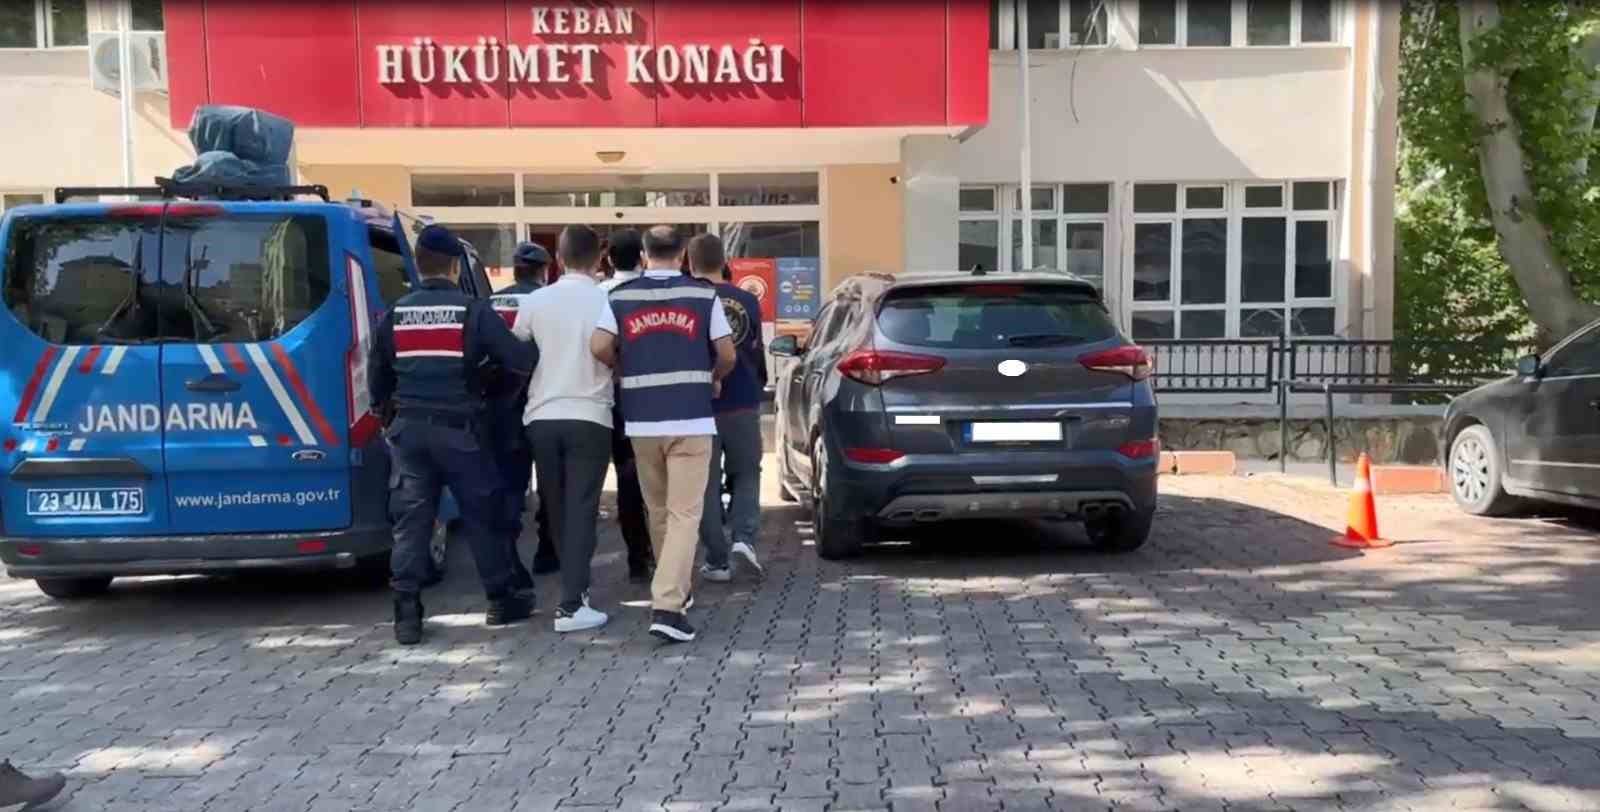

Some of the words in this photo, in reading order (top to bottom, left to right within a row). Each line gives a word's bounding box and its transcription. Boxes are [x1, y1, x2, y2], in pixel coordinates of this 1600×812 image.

[532, 8, 634, 35] KEBAN
[376, 37, 599, 84] HÜKÜMET
[627, 39, 785, 84] KONAĞI
[400, 311, 458, 325] JANDARMA
[629, 310, 696, 336] JANDARMA
[79, 402, 257, 432] JANDARMA
[38, 492, 59, 511] 23
[111, 490, 140, 510] 175
[175, 487, 341, 509] www.jandarma.gov.tr
